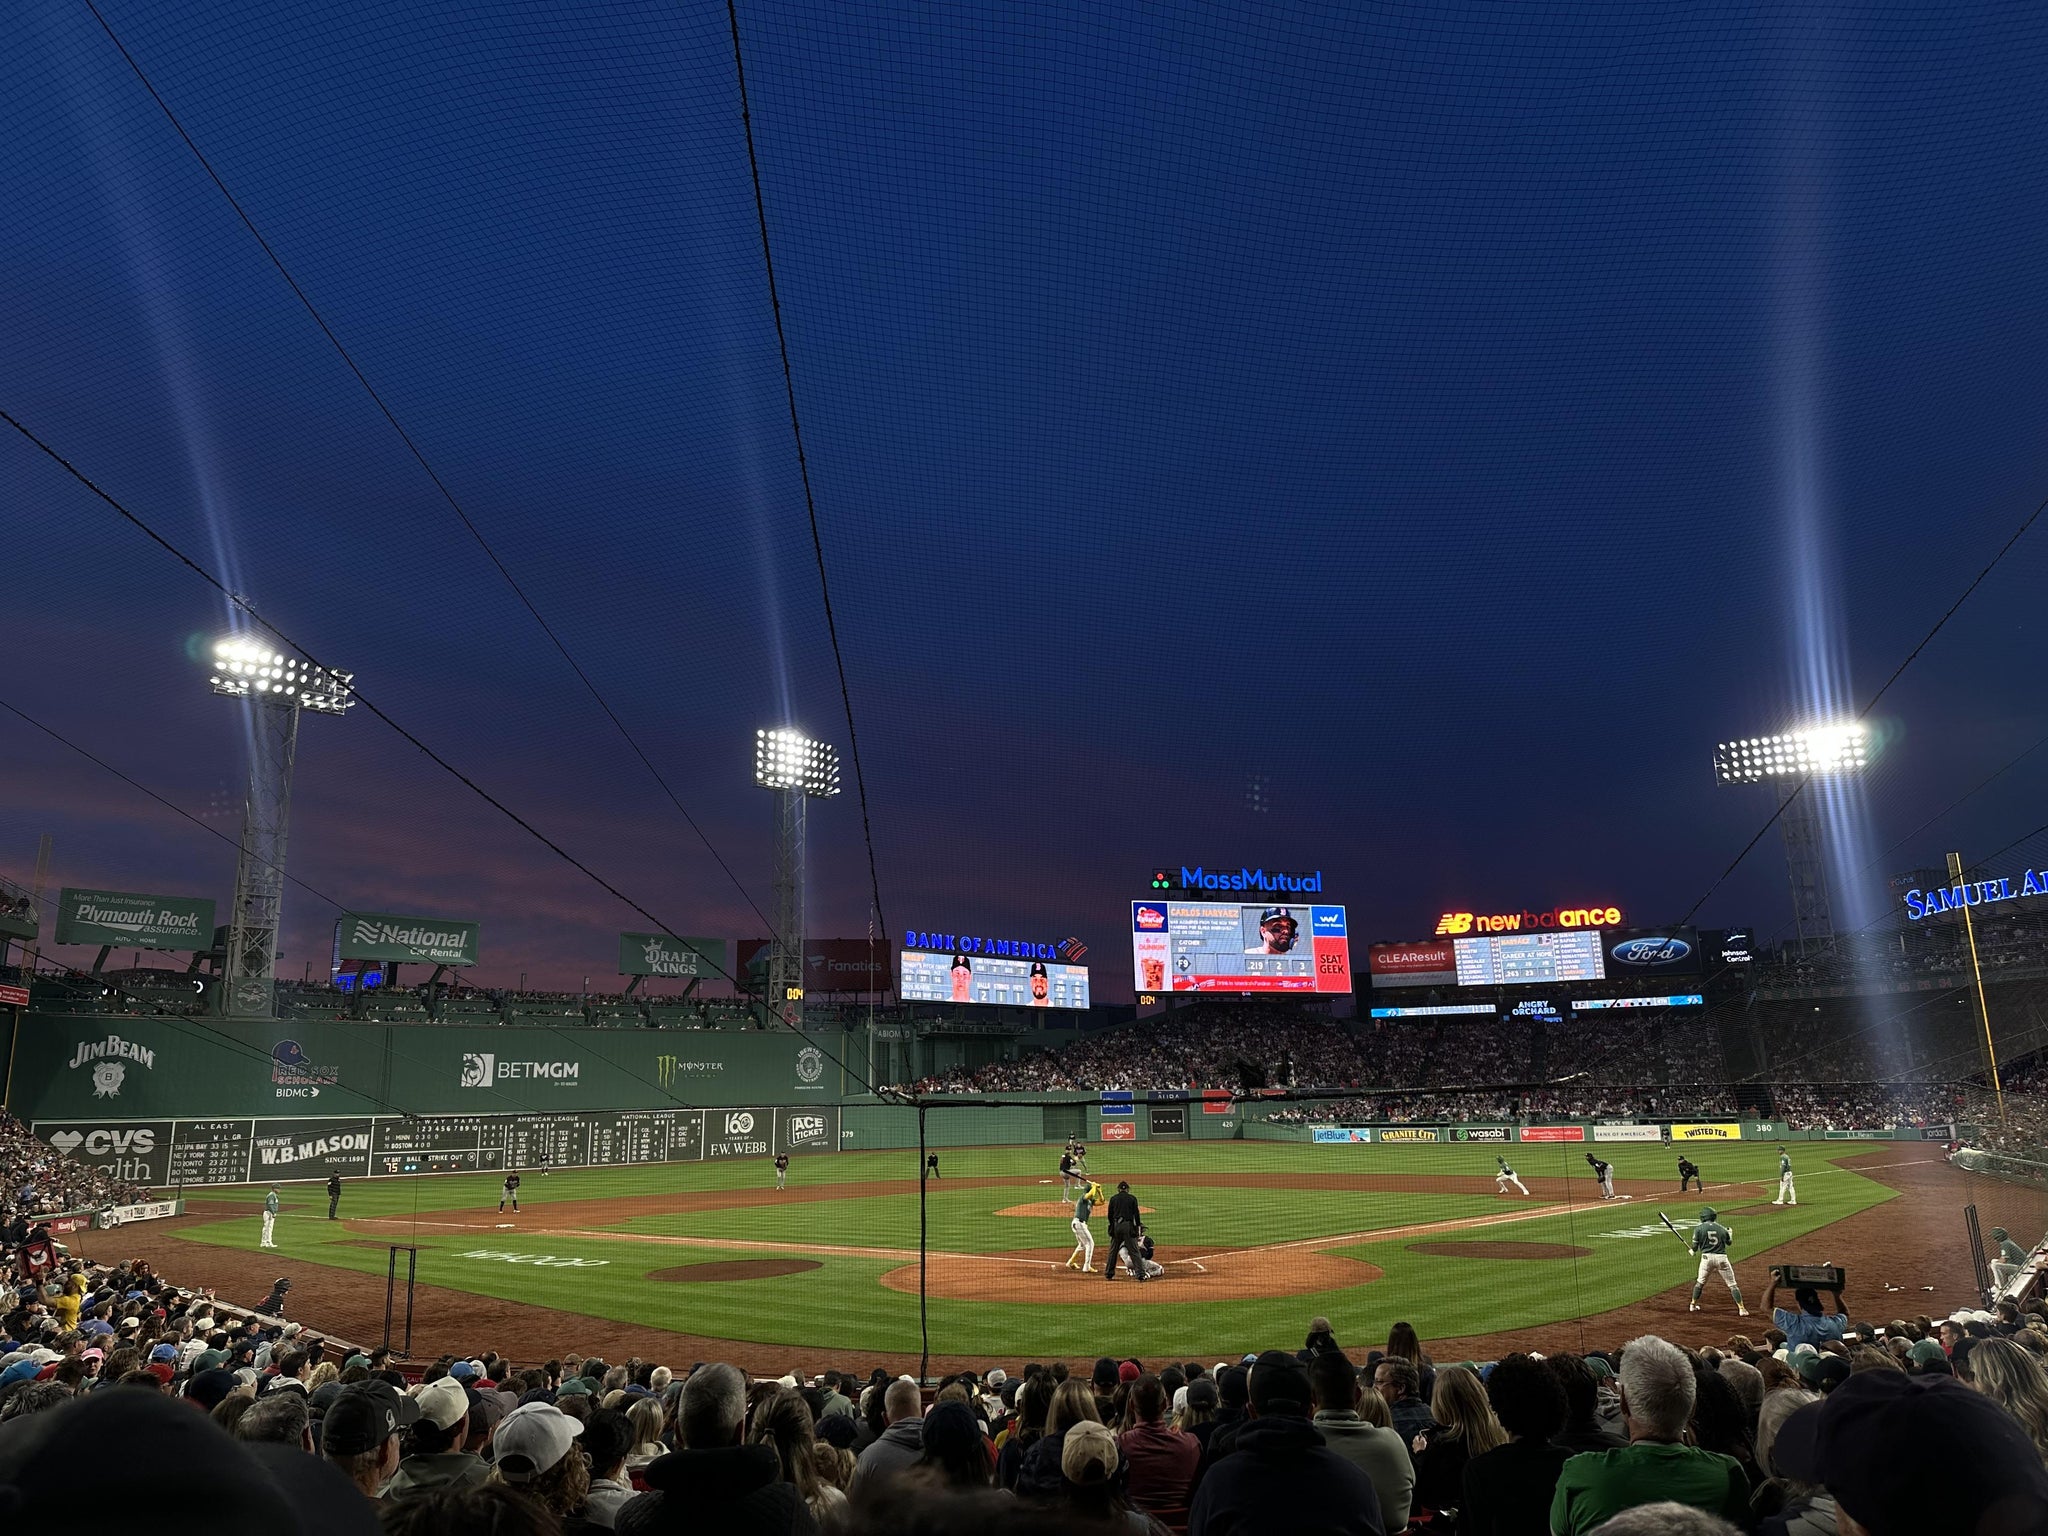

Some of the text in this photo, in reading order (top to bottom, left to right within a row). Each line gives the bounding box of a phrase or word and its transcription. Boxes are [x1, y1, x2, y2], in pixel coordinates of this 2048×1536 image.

[1181, 866, 1322, 893] MassMutual
[1904, 878, 2017, 920] SAMUEL
[76, 904, 199, 928] Plymouth Rock
[1170, 909, 1201, 917] CARLOS
[1476, 914, 1521, 932] new
[1523, 907, 1622, 929] balance
[143, 924, 198, 936] assurance
[380, 925, 467, 948] National
[906, 931, 1057, 959] BANK OF AMERICA
[410, 947, 463, 958] Car Rental
[645, 950, 699, 964] DRAFT
[1378, 951, 1446, 964] CLEAResult
[1628, 942, 1674, 961] Ford
[1722, 950, 1747, 958] Johnson
[1178, 960, 1305, 970] F9 .219 2 3
[1320, 954, 1343, 965] SEAT
[652, 962, 697, 975] KINGS
[828, 960, 882, 972] Fanatics
[1320, 965, 1345, 974] GEEK
[786, 988, 804, 1000] 0:04
[981, 991, 1020, 1002] 2 1 1
[1141, 996, 1156, 1005] 0:04
[1518, 1000, 1549, 1009] ANGRY
[1512, 1007, 1557, 1016] ORCHARD
[878, 1030, 910, 1039] ABIOMD
[69, 1035, 156, 1070] JIM BEAM
[279, 1066, 339, 1076] RED SOX
[498, 1062, 579, 1078] BETMGM
[678, 1061, 724, 1071] MONSTER
[106, 1073, 113, 1081] B
[276, 1089, 309, 1098] BIDMC
[725, 1113, 754, 1134] 160
[795, 1117, 824, 1131] ACE
[795, 1128, 824, 1140] TICKET
[1317, 1131, 1345, 1140] jetBlue
[1382, 1129, 1437, 1141] GRANITE CITY
[1469, 1128, 1505, 1138] wasabi
[1684, 1128, 1728, 1139] TWISTED TEA
[85, 1129, 155, 1156] CVS
[256, 1138, 292, 1147] WHO BUT
[710, 1142, 767, 1156] F.W. WEBB
[97, 1157, 152, 1181] alth
[386, 1163, 398, 1173] 75
[134, 1207, 146, 1217] TRULY
[159, 1204, 170, 1214] TRULY
[1707, 1231, 1719, 1245] 5
